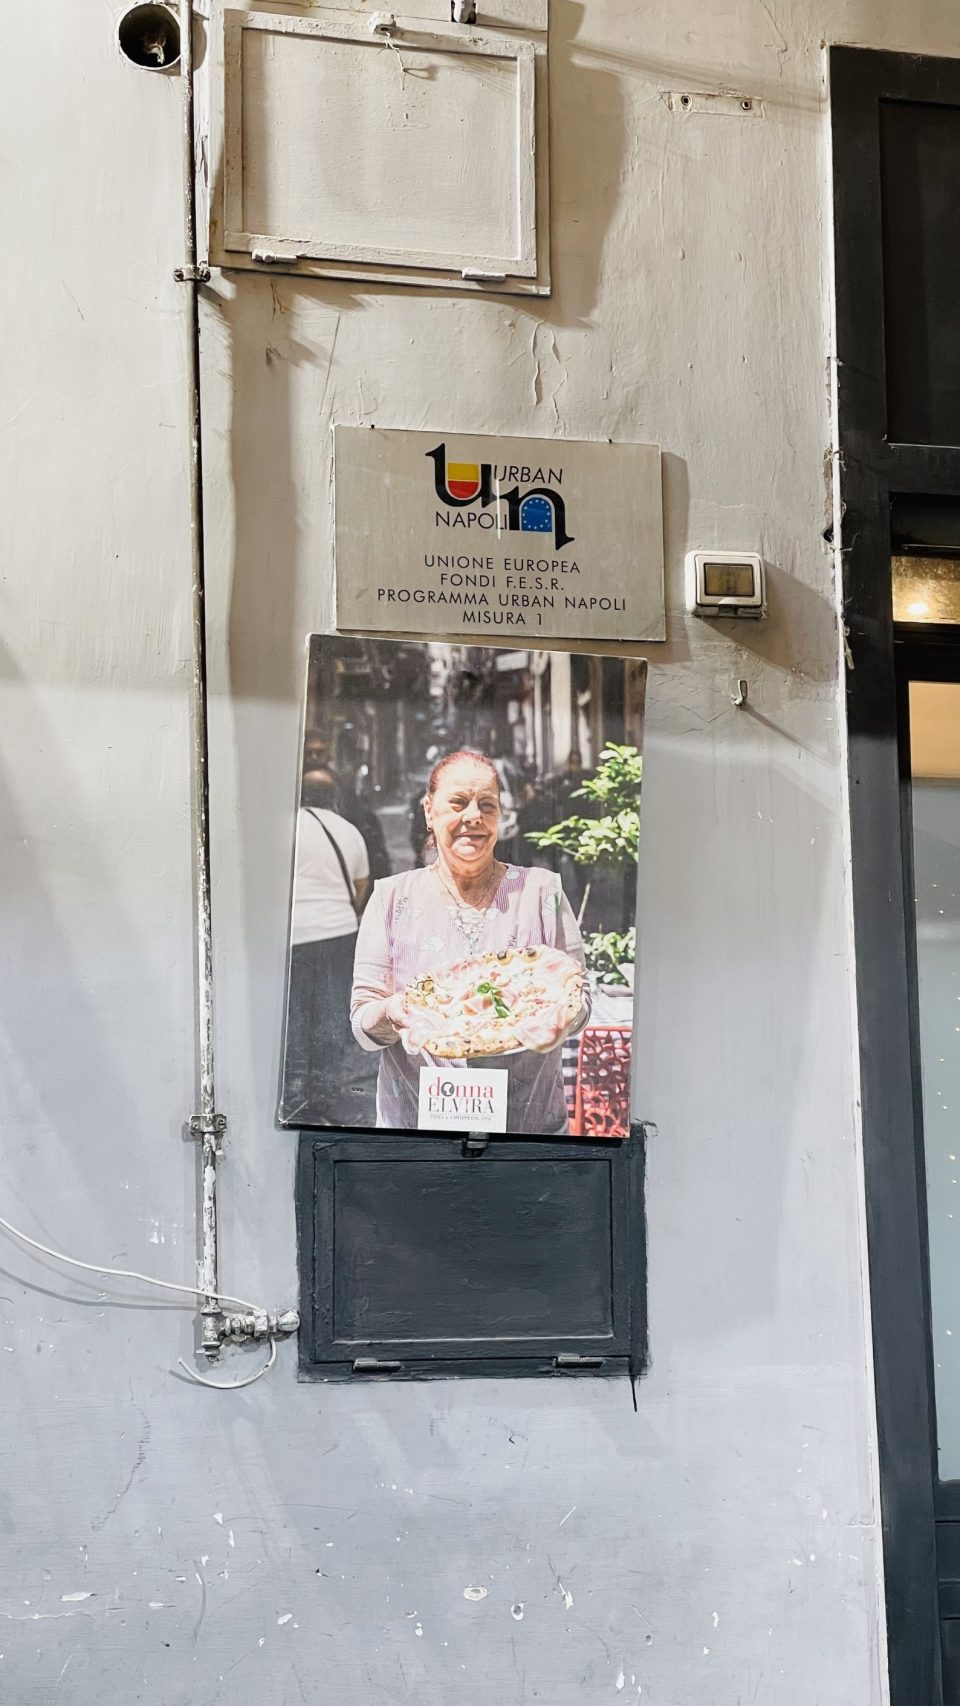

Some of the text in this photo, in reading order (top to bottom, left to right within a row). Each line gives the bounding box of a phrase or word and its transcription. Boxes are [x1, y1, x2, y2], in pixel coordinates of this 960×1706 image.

[494, 465, 563, 485] URBAN
[435, 511, 507, 530] NAPOLI
[424, 554, 581, 574] UNIONE EUROPEA
[440, 573, 565, 591] FONDI F.E.S.R.
[377, 588, 626, 611] PROGRAMMA URBAN NAPOLI
[462, 610, 543, 626] MISURA 1
[428, 1077, 494, 1098] donna
[428, 1097, 494, 1113] ELVIRA
